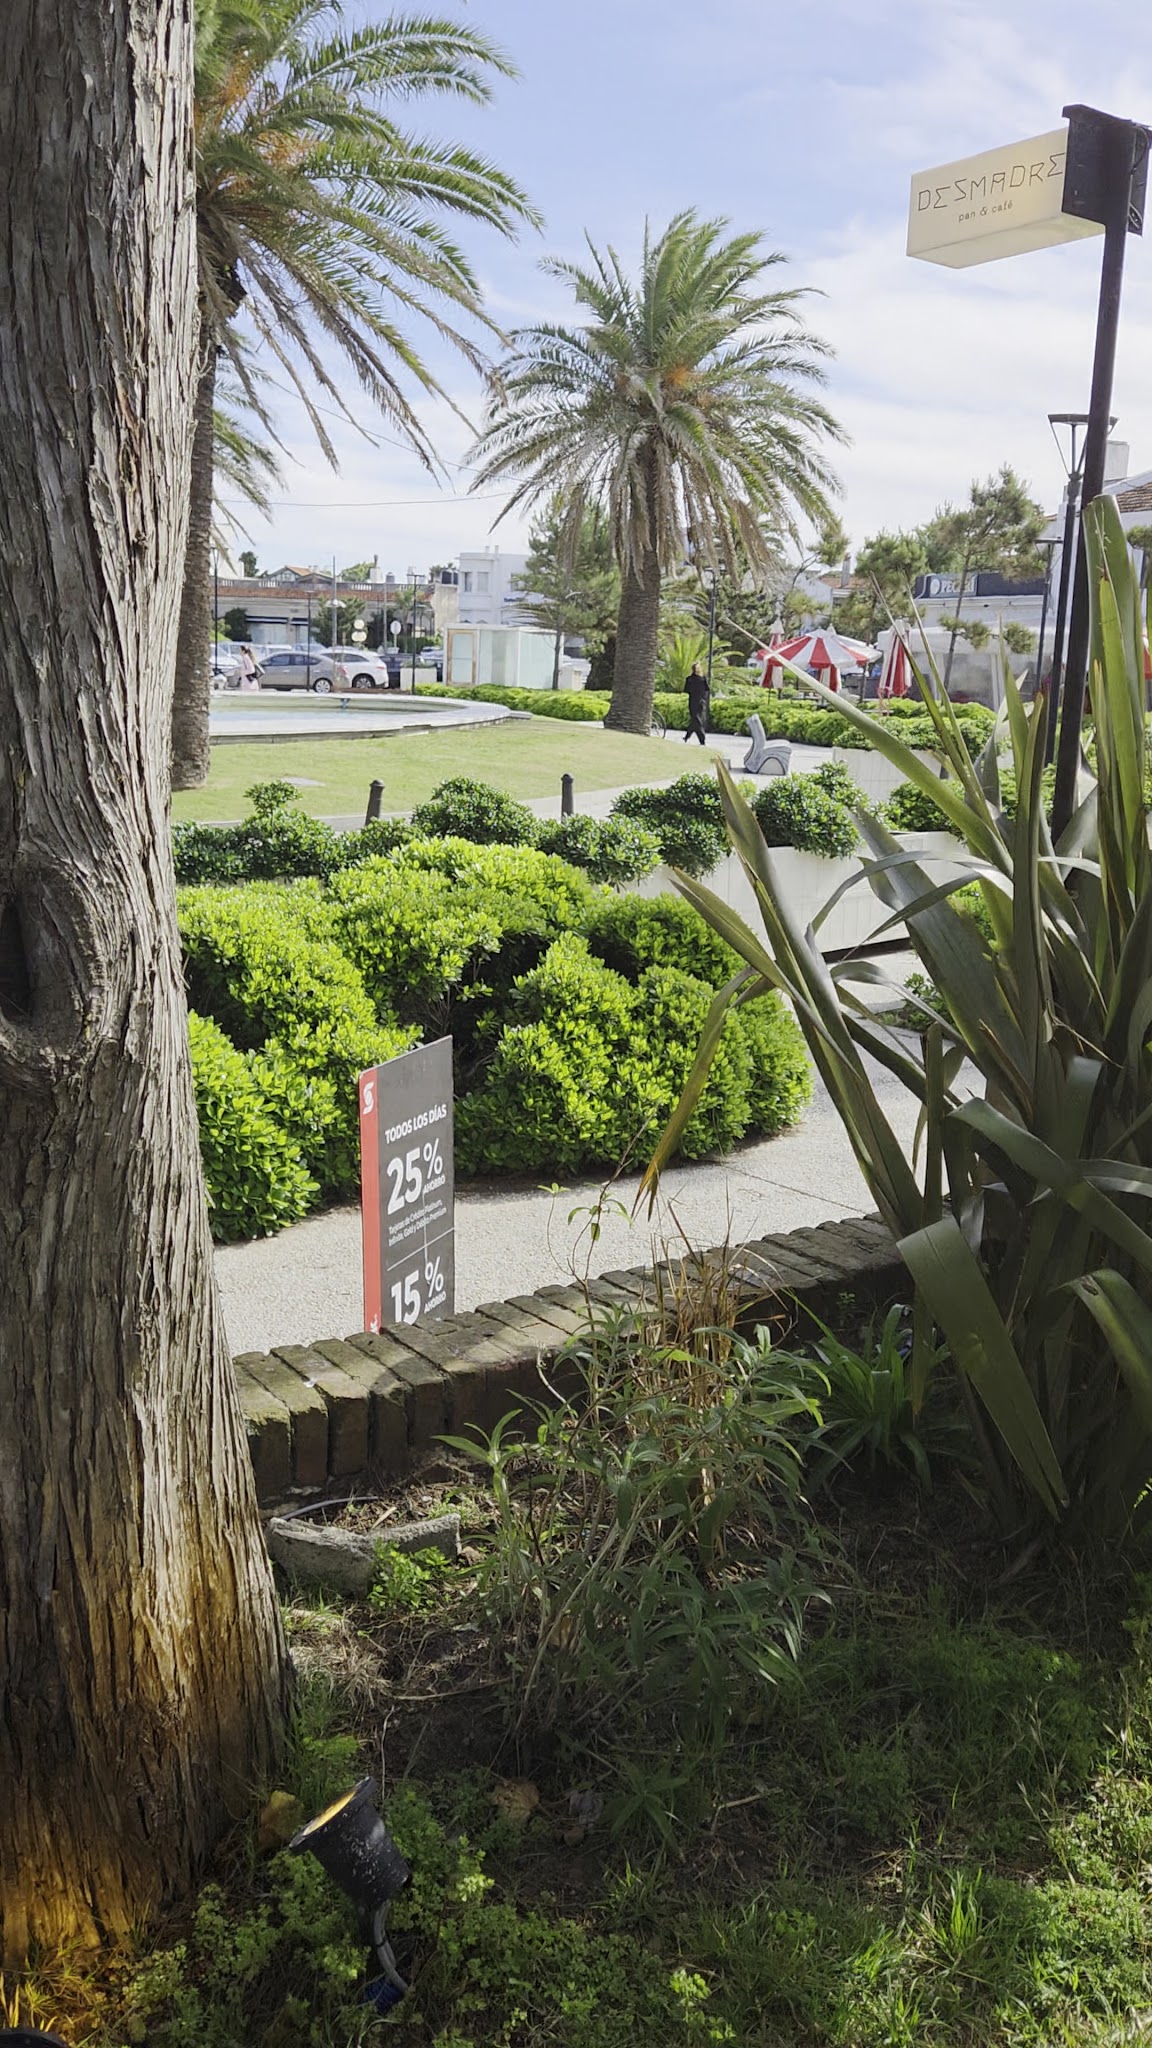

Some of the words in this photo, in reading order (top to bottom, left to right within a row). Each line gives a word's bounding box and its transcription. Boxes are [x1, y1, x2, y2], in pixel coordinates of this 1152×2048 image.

[918, 152, 1065, 211] DESMADRE
[958, 208, 976, 222] pan
[979, 207, 988, 216] &
[991, 200, 1013, 213] café
[385, 1119, 413, 1144] TODOS
[413, 1112, 428, 1131] LOS
[428, 1104, 447, 1124] DÍAS
[423, 1290, 447, 1314] AHORRO
